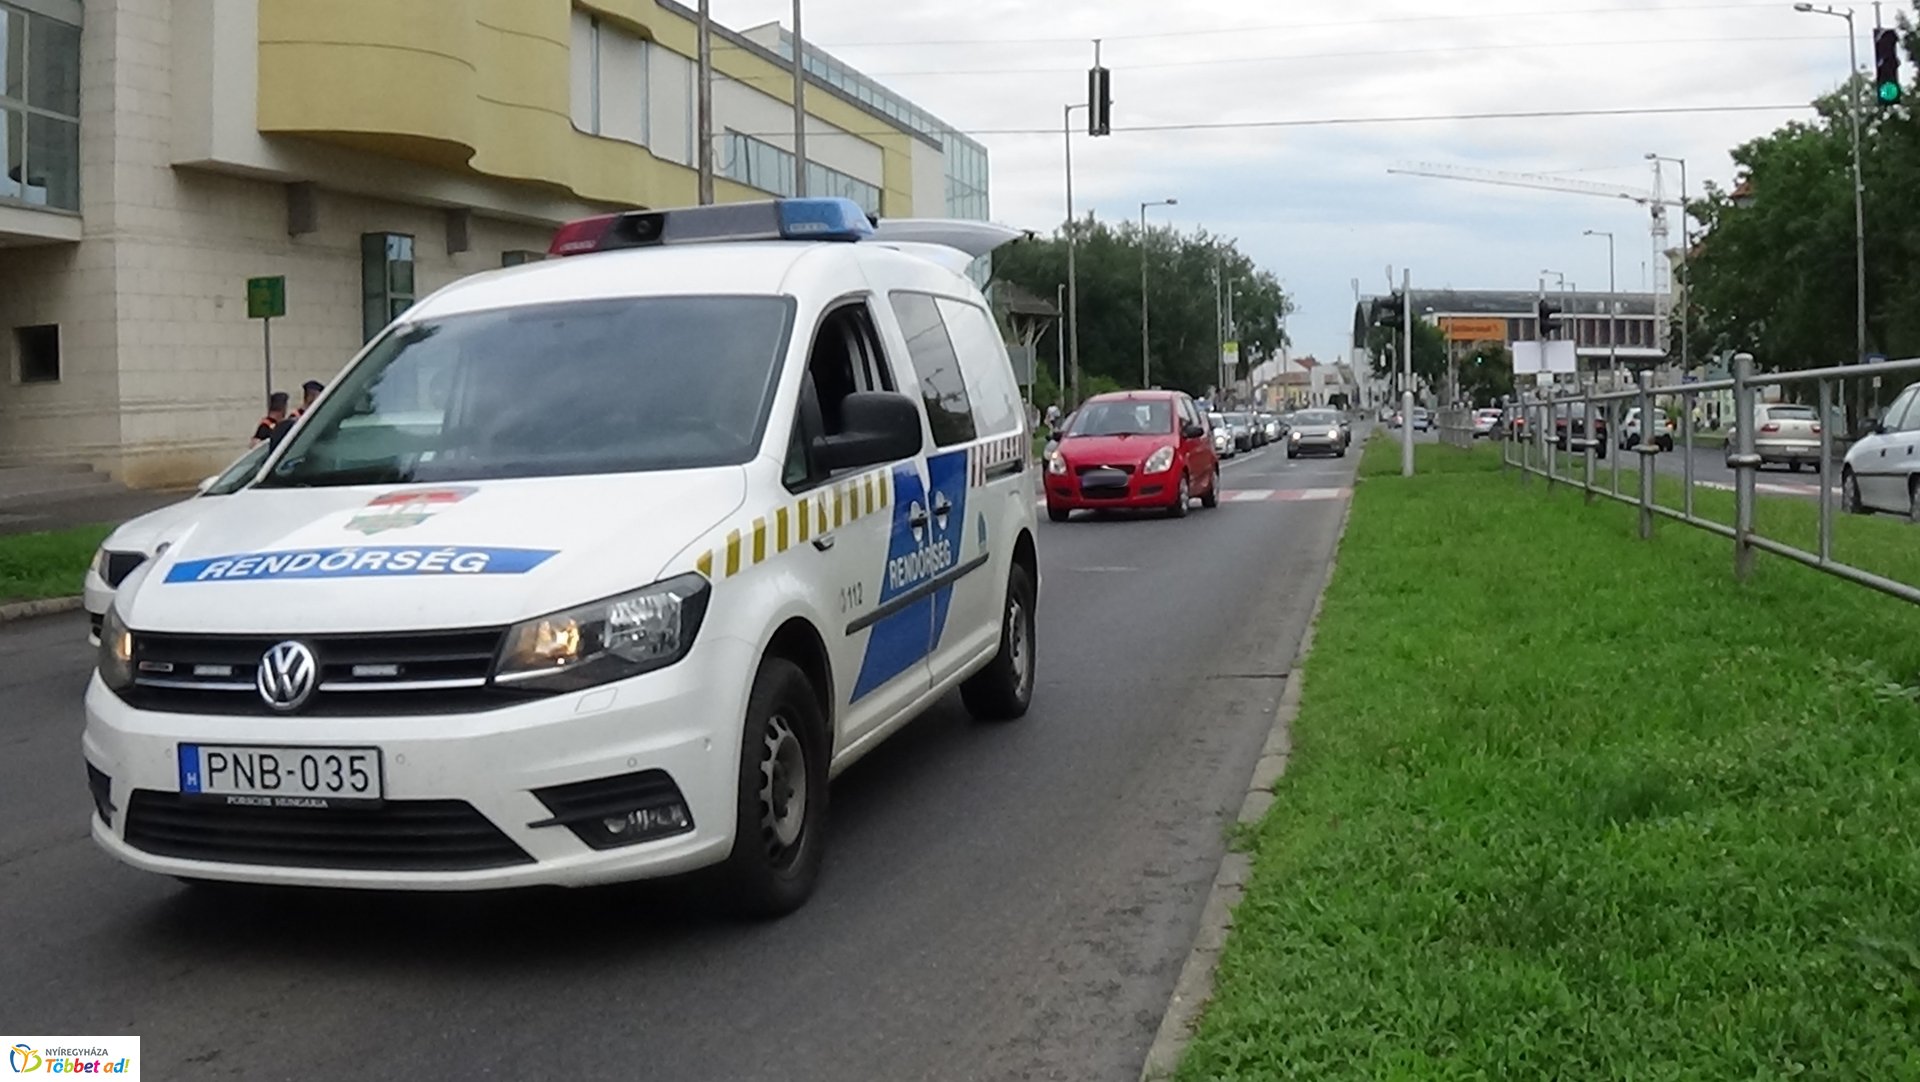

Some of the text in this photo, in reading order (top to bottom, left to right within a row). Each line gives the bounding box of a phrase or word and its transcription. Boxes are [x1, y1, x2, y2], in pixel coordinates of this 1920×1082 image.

[197, 546, 490, 581] RENDŐRSÉG
[888, 533, 952, 591] RENDŐRSÉG
[847, 581, 863, 609] 112
[187, 773, 198, 786] H
[207, 752, 369, 793] PNB-035
